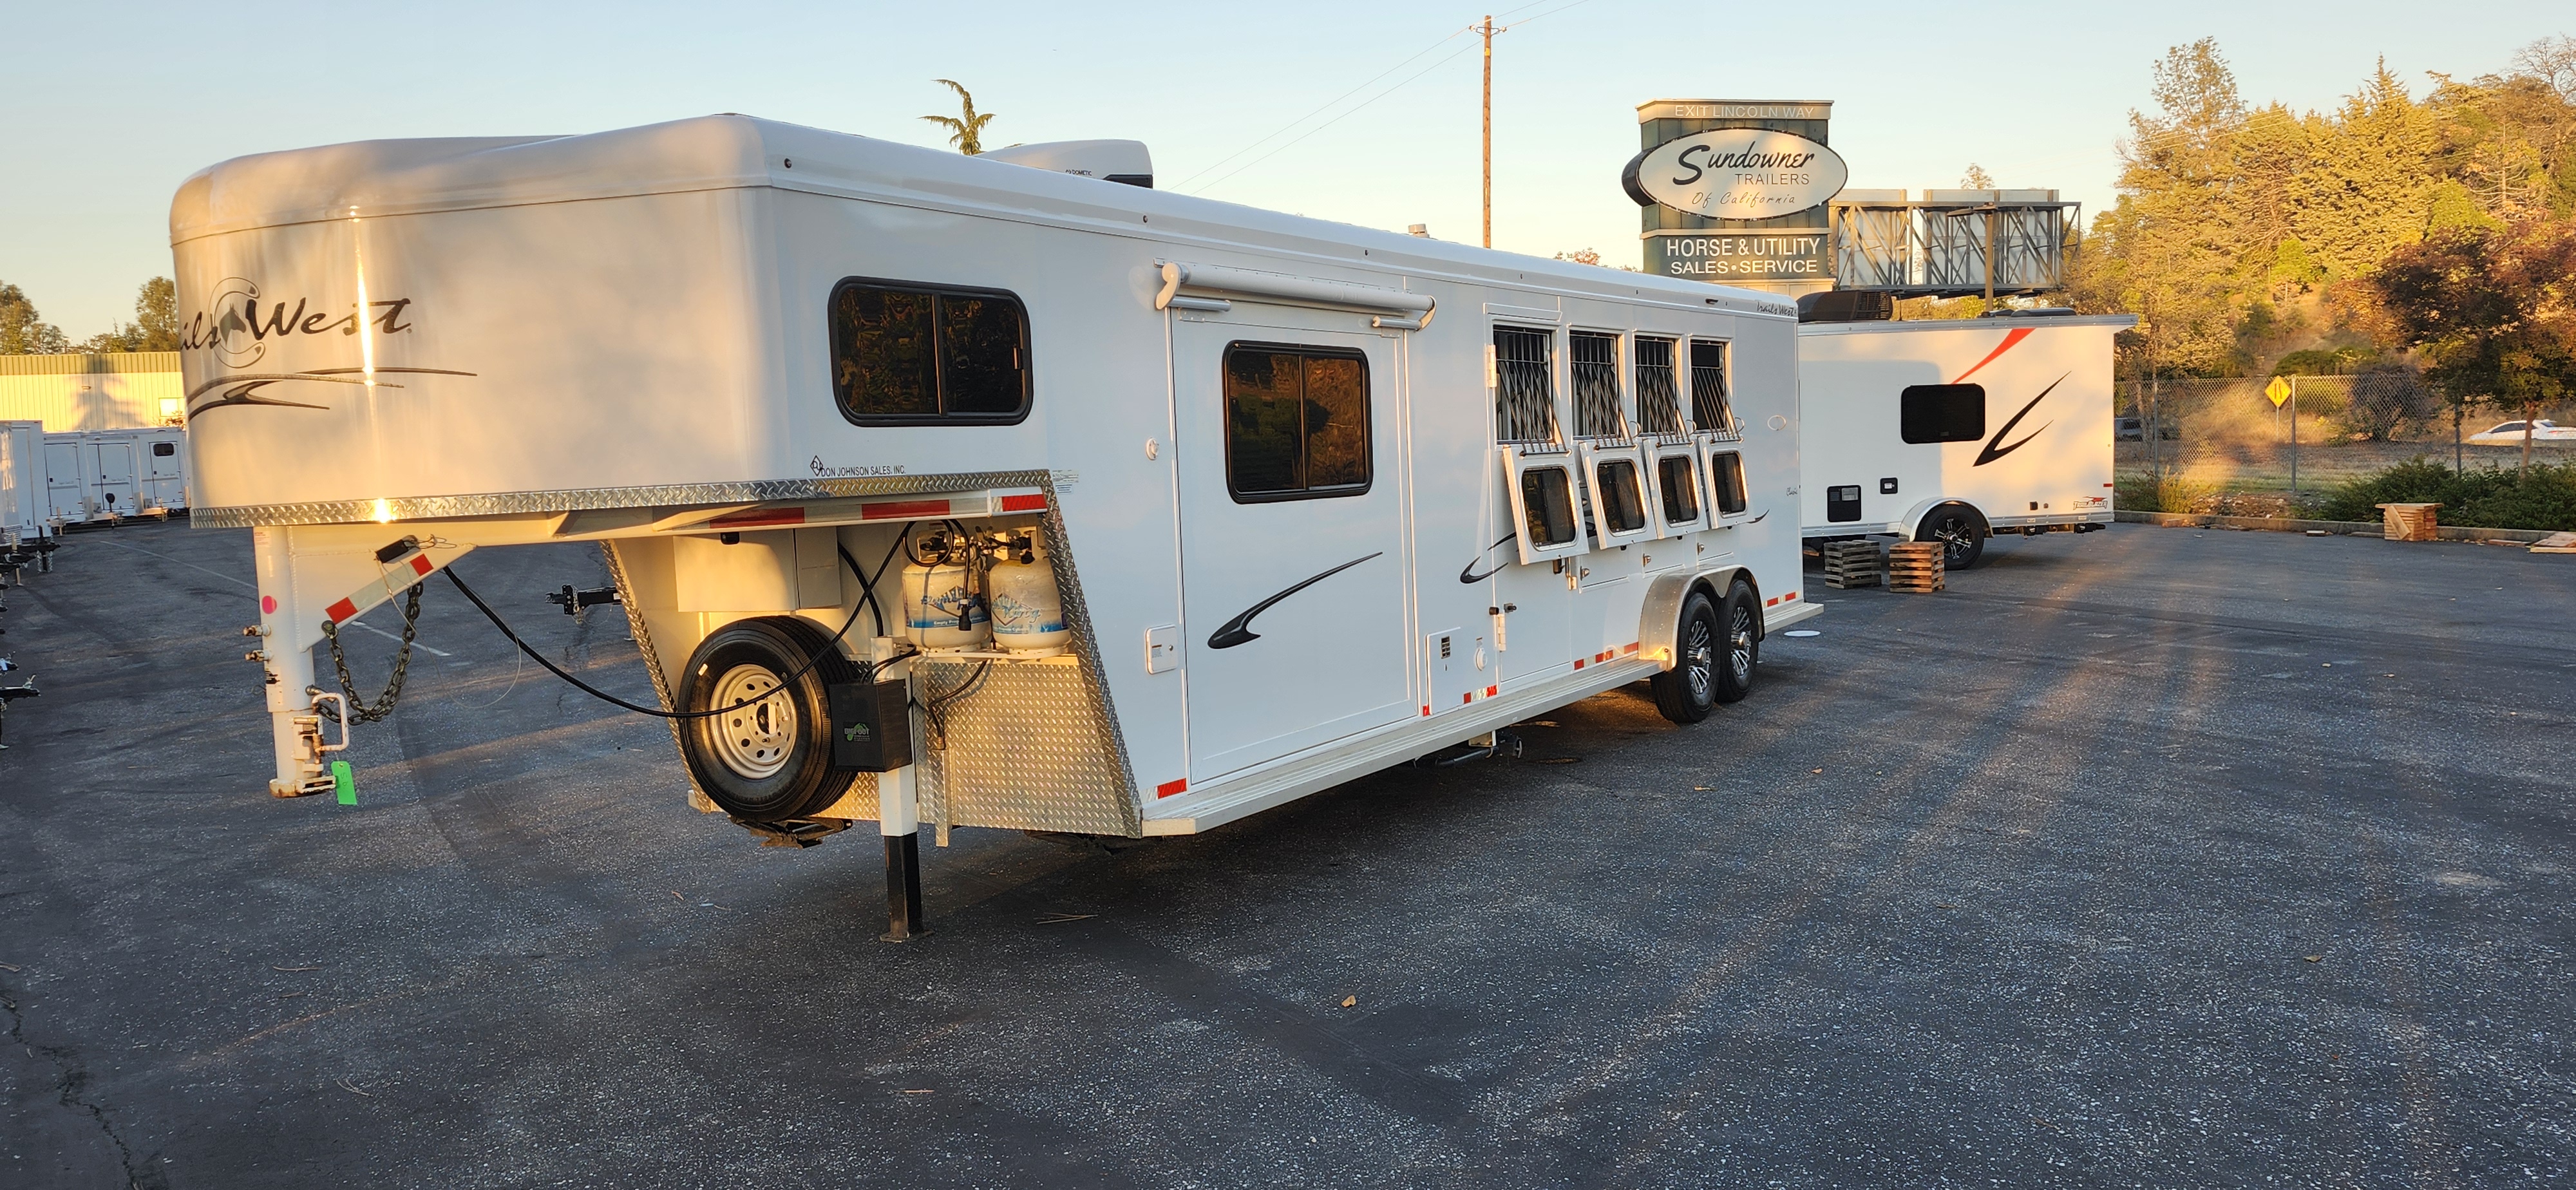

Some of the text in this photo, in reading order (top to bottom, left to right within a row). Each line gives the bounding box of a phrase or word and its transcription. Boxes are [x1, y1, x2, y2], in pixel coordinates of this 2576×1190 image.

[1674, 106, 1815, 118] EXIT LINCOLN WAY
[1672, 140, 1815, 185] Sundowner
[1735, 173, 1810, 185] TRAILERS
[1692, 191, 1795, 209] Of California
[1667, 238, 1821, 257] HORSE & UTILITY
[1671, 260, 1817, 274] SALES SERVICE
[245, 297, 412, 341] West
[820, 468, 836, 477] DON
[838, 466, 869, 477] JOHNSON
